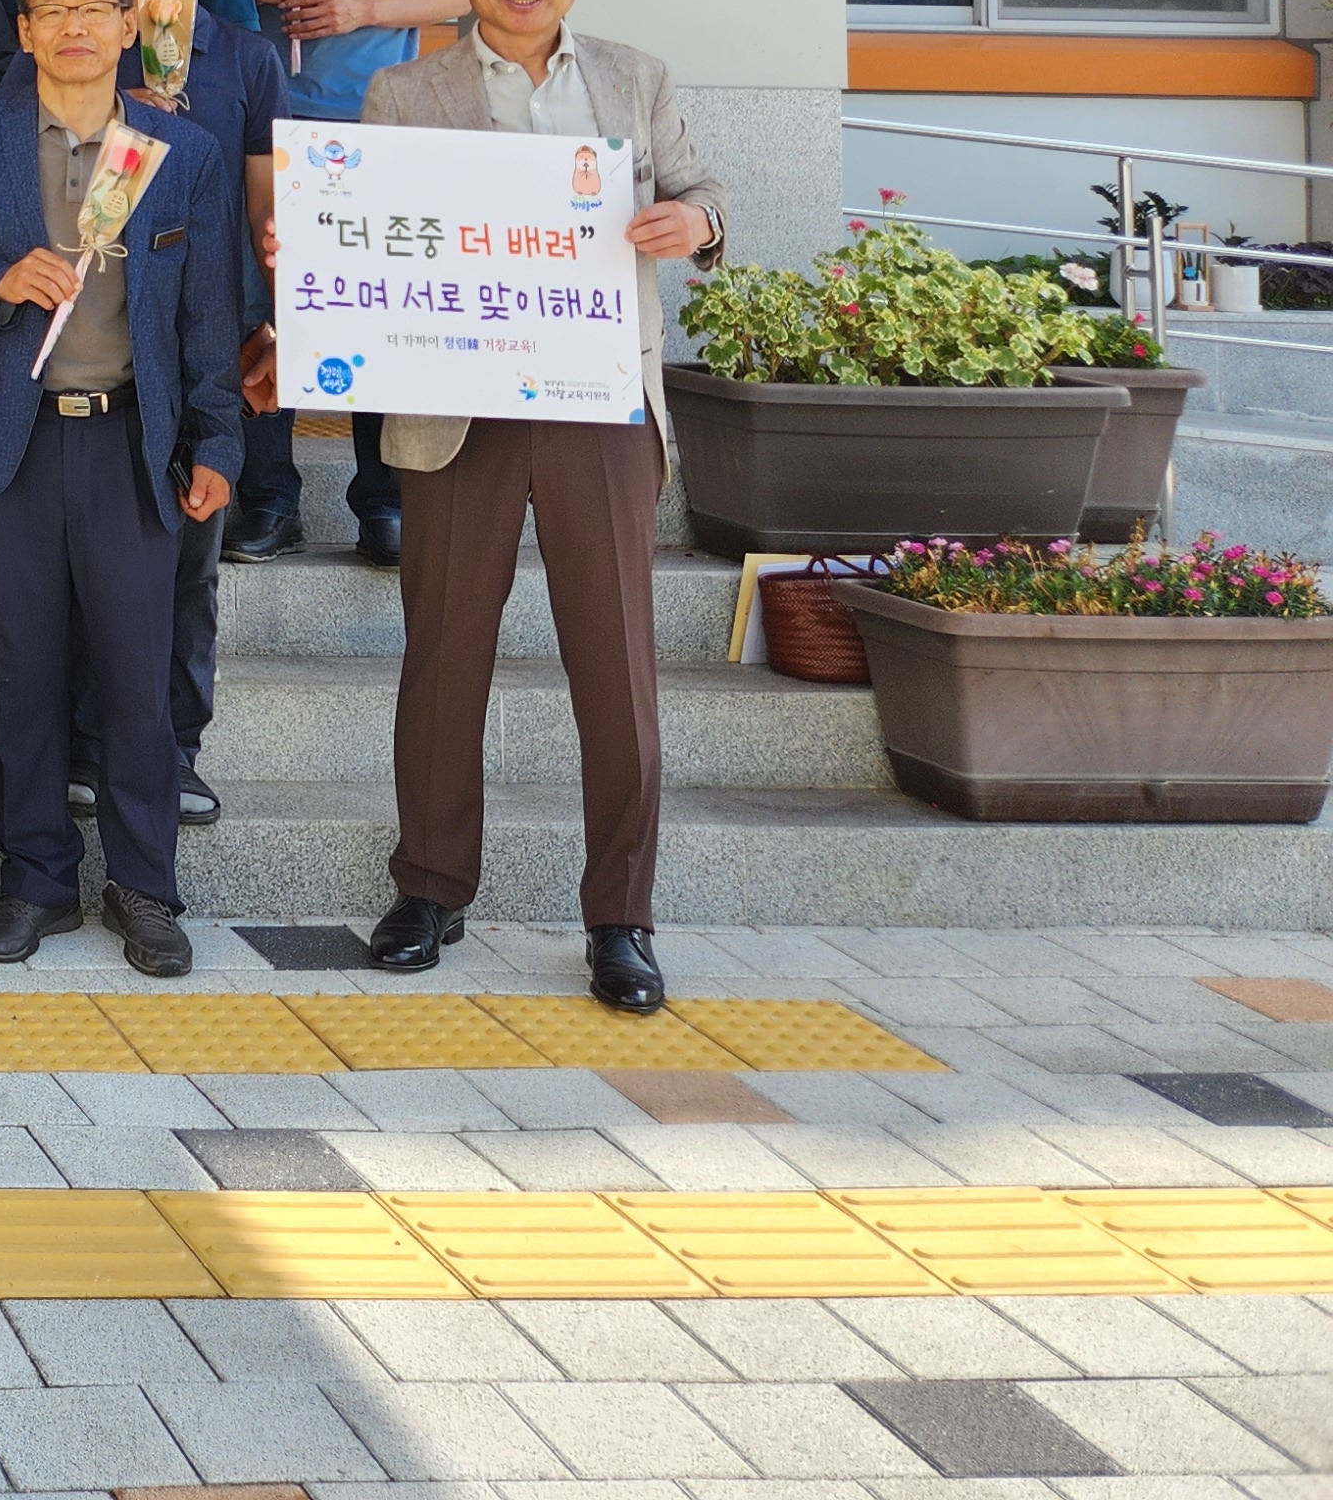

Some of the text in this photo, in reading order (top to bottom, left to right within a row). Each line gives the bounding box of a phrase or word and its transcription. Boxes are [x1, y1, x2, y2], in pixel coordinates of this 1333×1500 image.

[318, 212, 594, 260] “더 존중 더 배려”
[296, 272, 621, 324] 웃으며 서로 맞이해요!
[387, 334, 398, 347] 더
[403, 334, 438, 348] 가까이
[483, 338, 536, 353] 거창교육!
